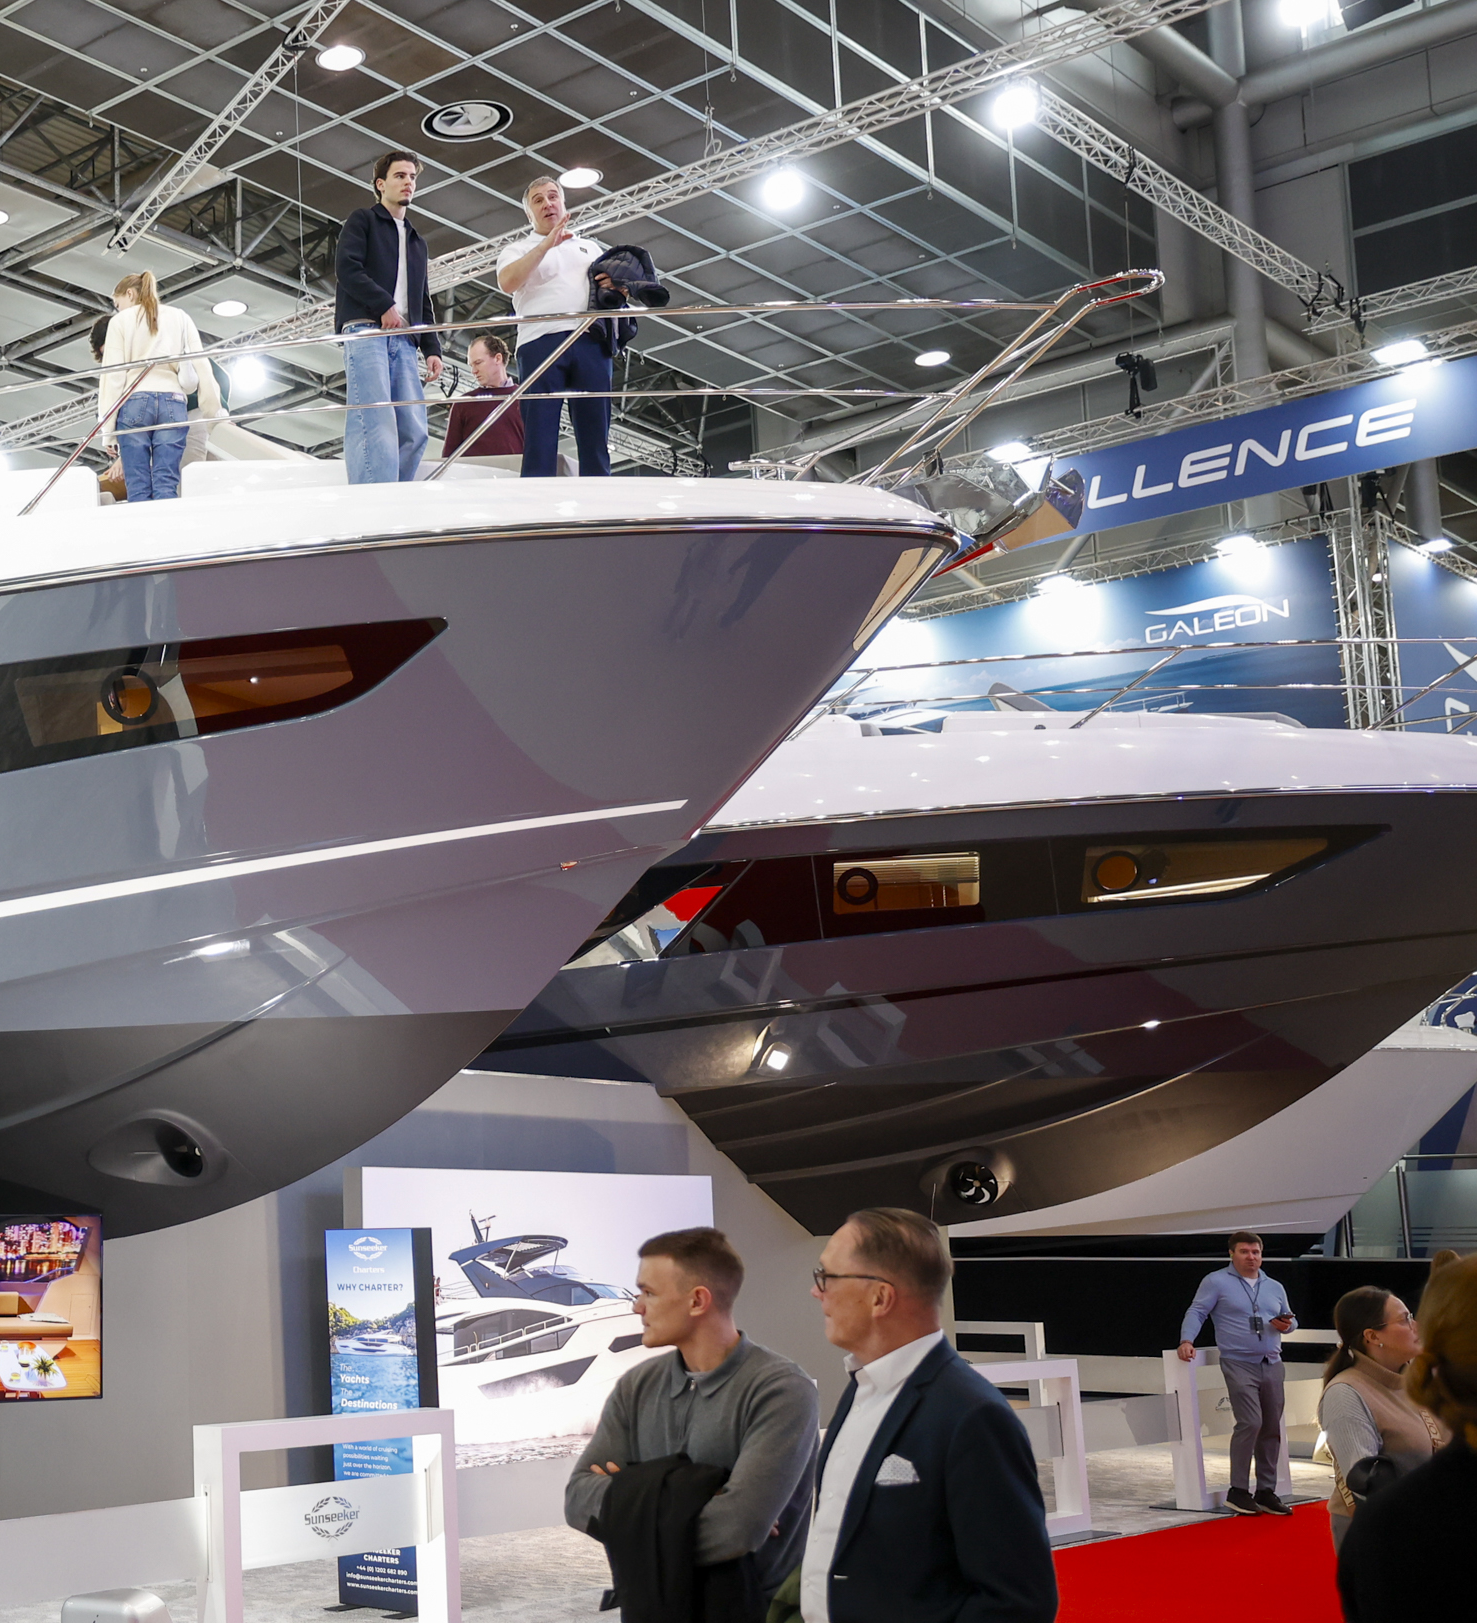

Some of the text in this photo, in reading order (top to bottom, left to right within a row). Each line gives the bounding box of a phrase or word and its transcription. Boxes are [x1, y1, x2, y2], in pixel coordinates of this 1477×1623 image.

[1087, 398, 1417, 509] LLENCE
[1145, 598, 1290, 644] GALEON
[348, 1244, 388, 1252] Sunseeker
[352, 1266, 385, 1274] Charters
[337, 1283, 404, 1292] WHY CHARTER?
[340, 1374, 370, 1384] Yachts
[341, 1398, 398, 1410] Destinations
[304, 1509, 360, 1526] Sunseeker
[363, 1554, 400, 1565] CHARTERS
